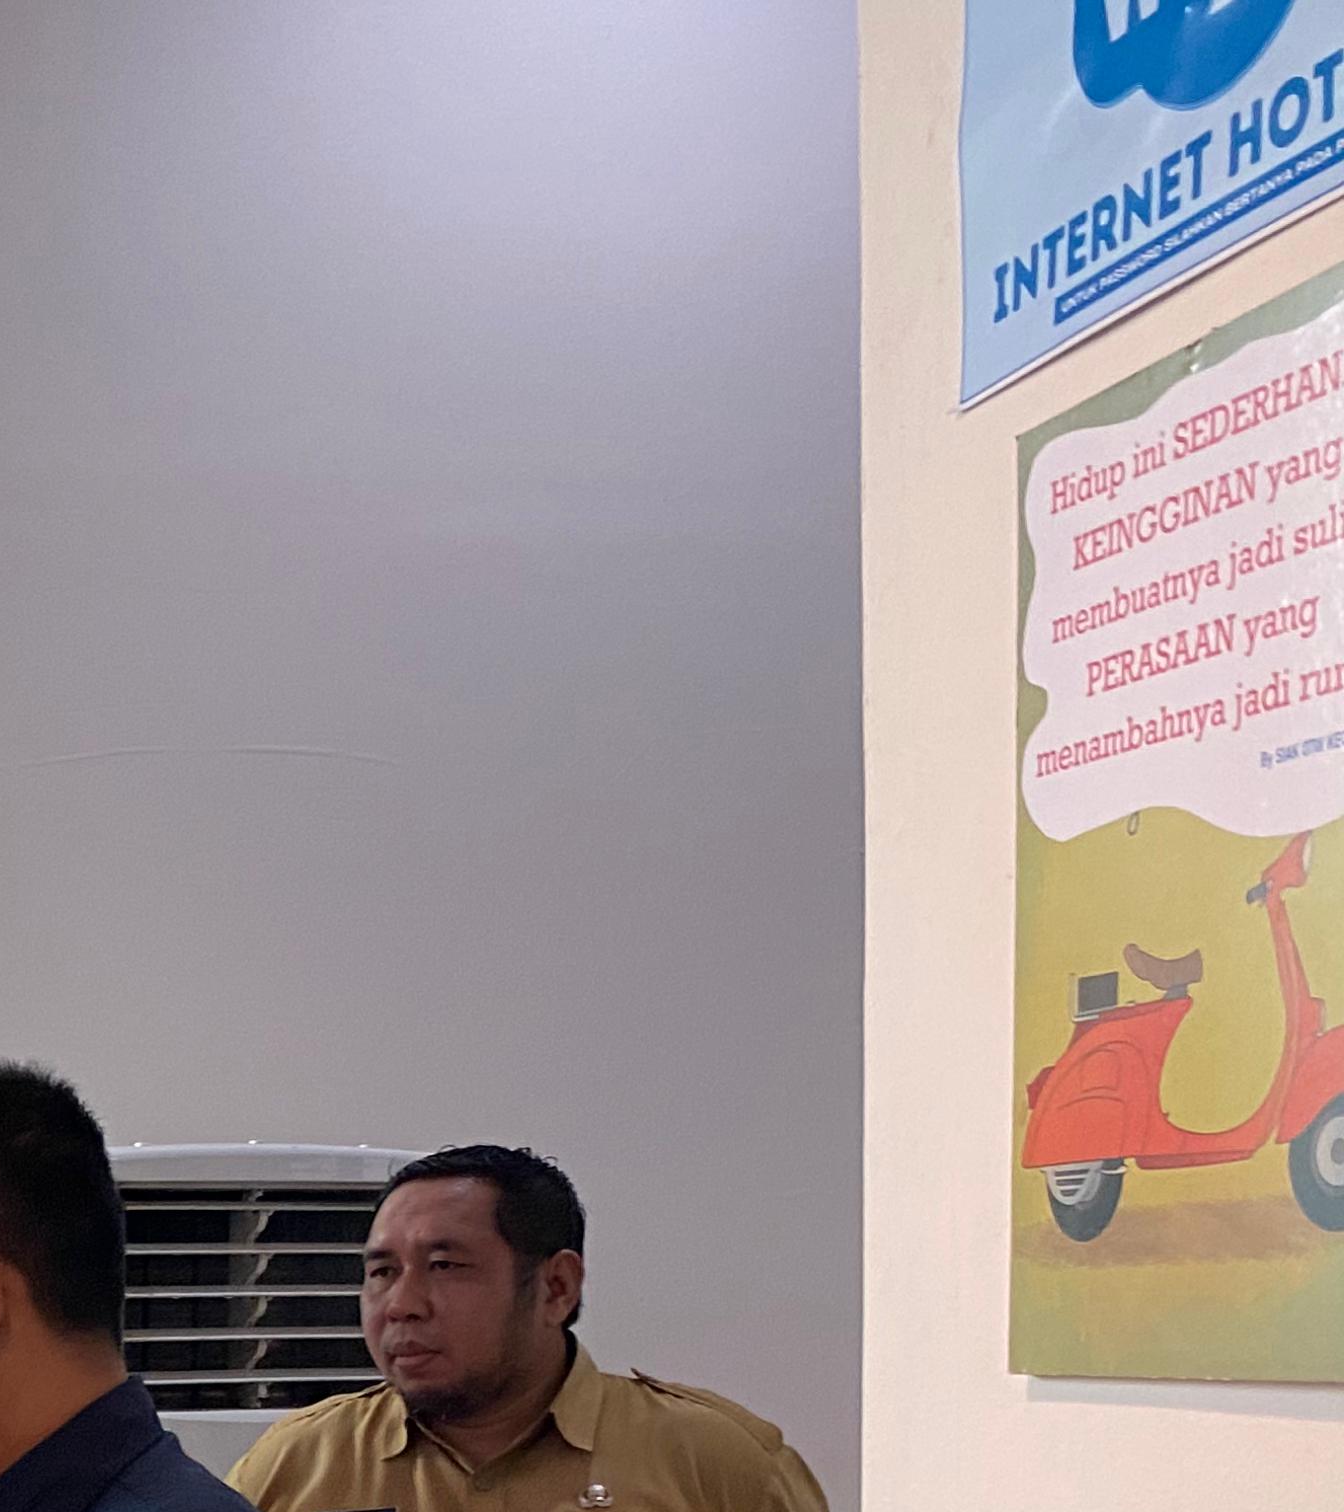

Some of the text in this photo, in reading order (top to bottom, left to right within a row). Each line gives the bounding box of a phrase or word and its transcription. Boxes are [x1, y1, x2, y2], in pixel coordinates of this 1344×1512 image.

[993, 48, 1344, 324] INTERNET HOT
[1050, 460, 1125, 514] Hidup
[1132, 431, 1167, 479] ini
[1072, 436, 1344, 571] KEINGGINAN yang
[1051, 559, 1220, 644] membuatnya
[1226, 523, 1285, 590] jadi
[1085, 597, 1320, 697] PERASAAN yang
[1035, 697, 1227, 778] menambahnya
[1233, 668, 1291, 731] jadi
